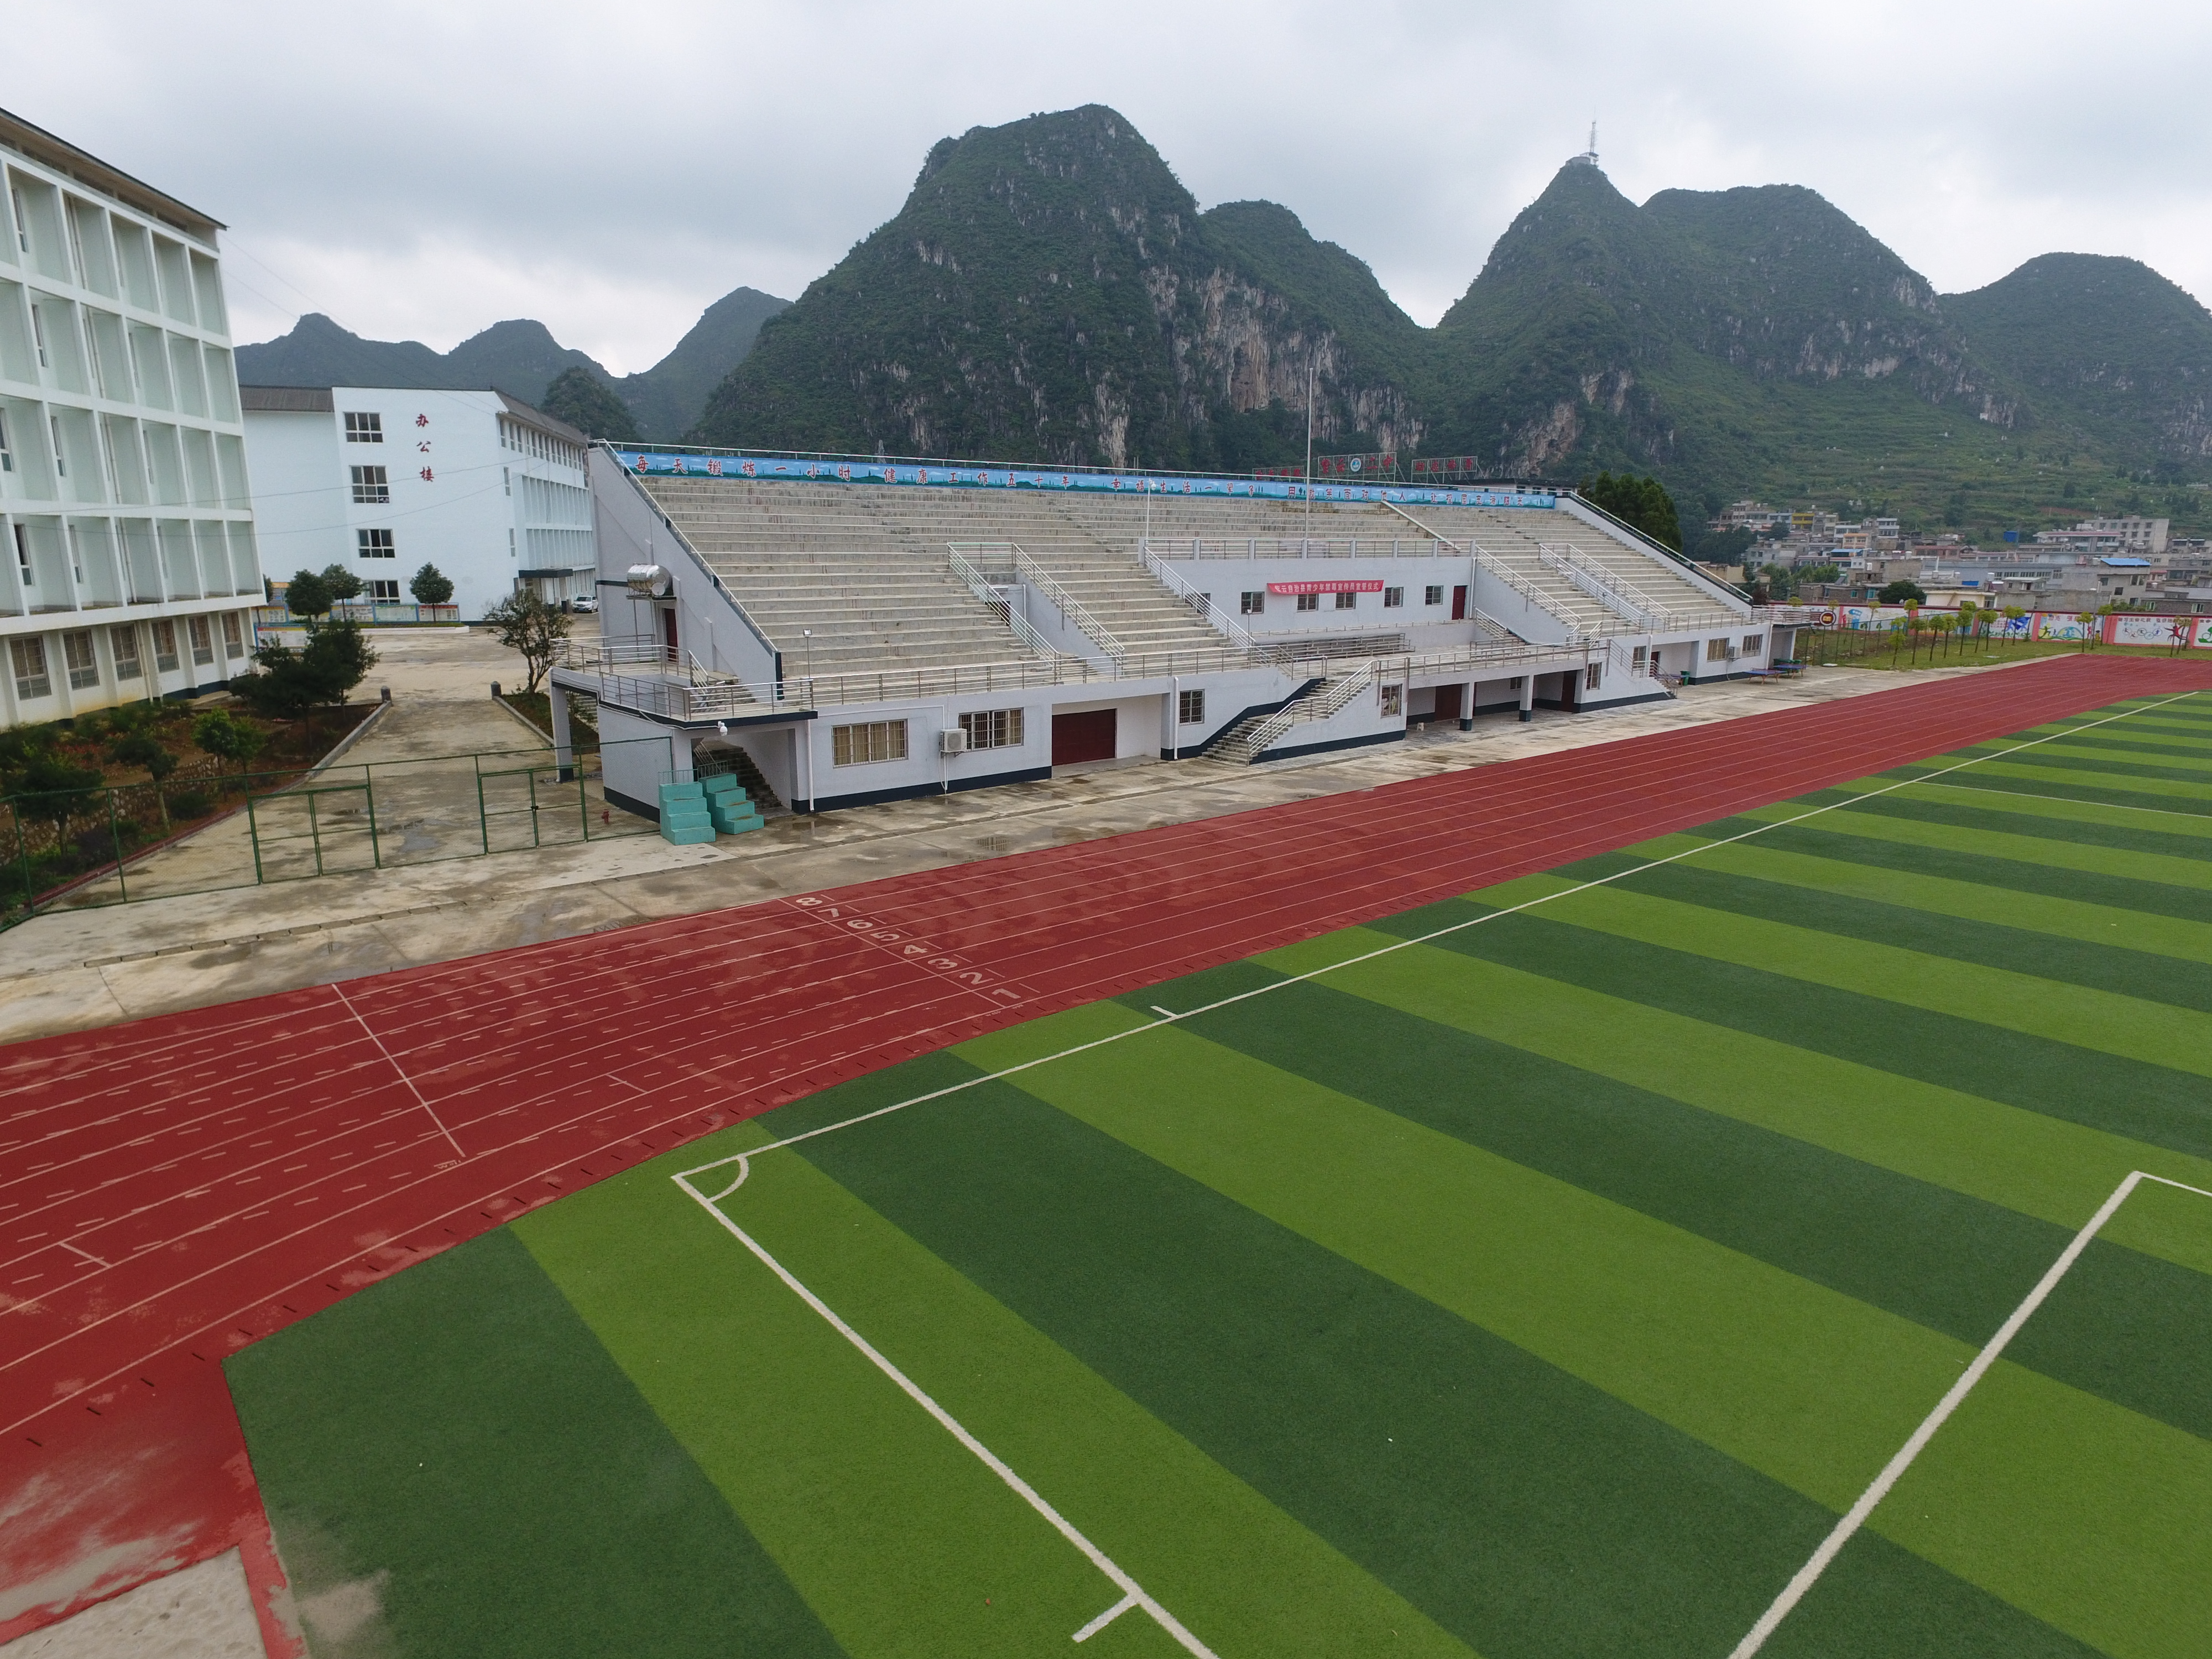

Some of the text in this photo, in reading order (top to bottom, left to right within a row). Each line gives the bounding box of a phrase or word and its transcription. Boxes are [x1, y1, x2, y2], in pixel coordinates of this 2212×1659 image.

[415, 414, 435, 482] 办公楼
[635, 455, 851, 482] 每天锻炼一小时
[884, 467, 1070, 490] 健康工作五十年
[1110, 476, 1256, 497] 幸福生活一辈子
[796, 897, 823, 906] 8
[818, 908, 839, 917] 7
[847, 919, 873, 929] 6
[870, 931, 900, 941] 5
[904, 945, 928, 955] 4
[927, 958, 958, 969] 3
[959, 972, 994, 985] 2
[992, 988, 1021, 999] 1
